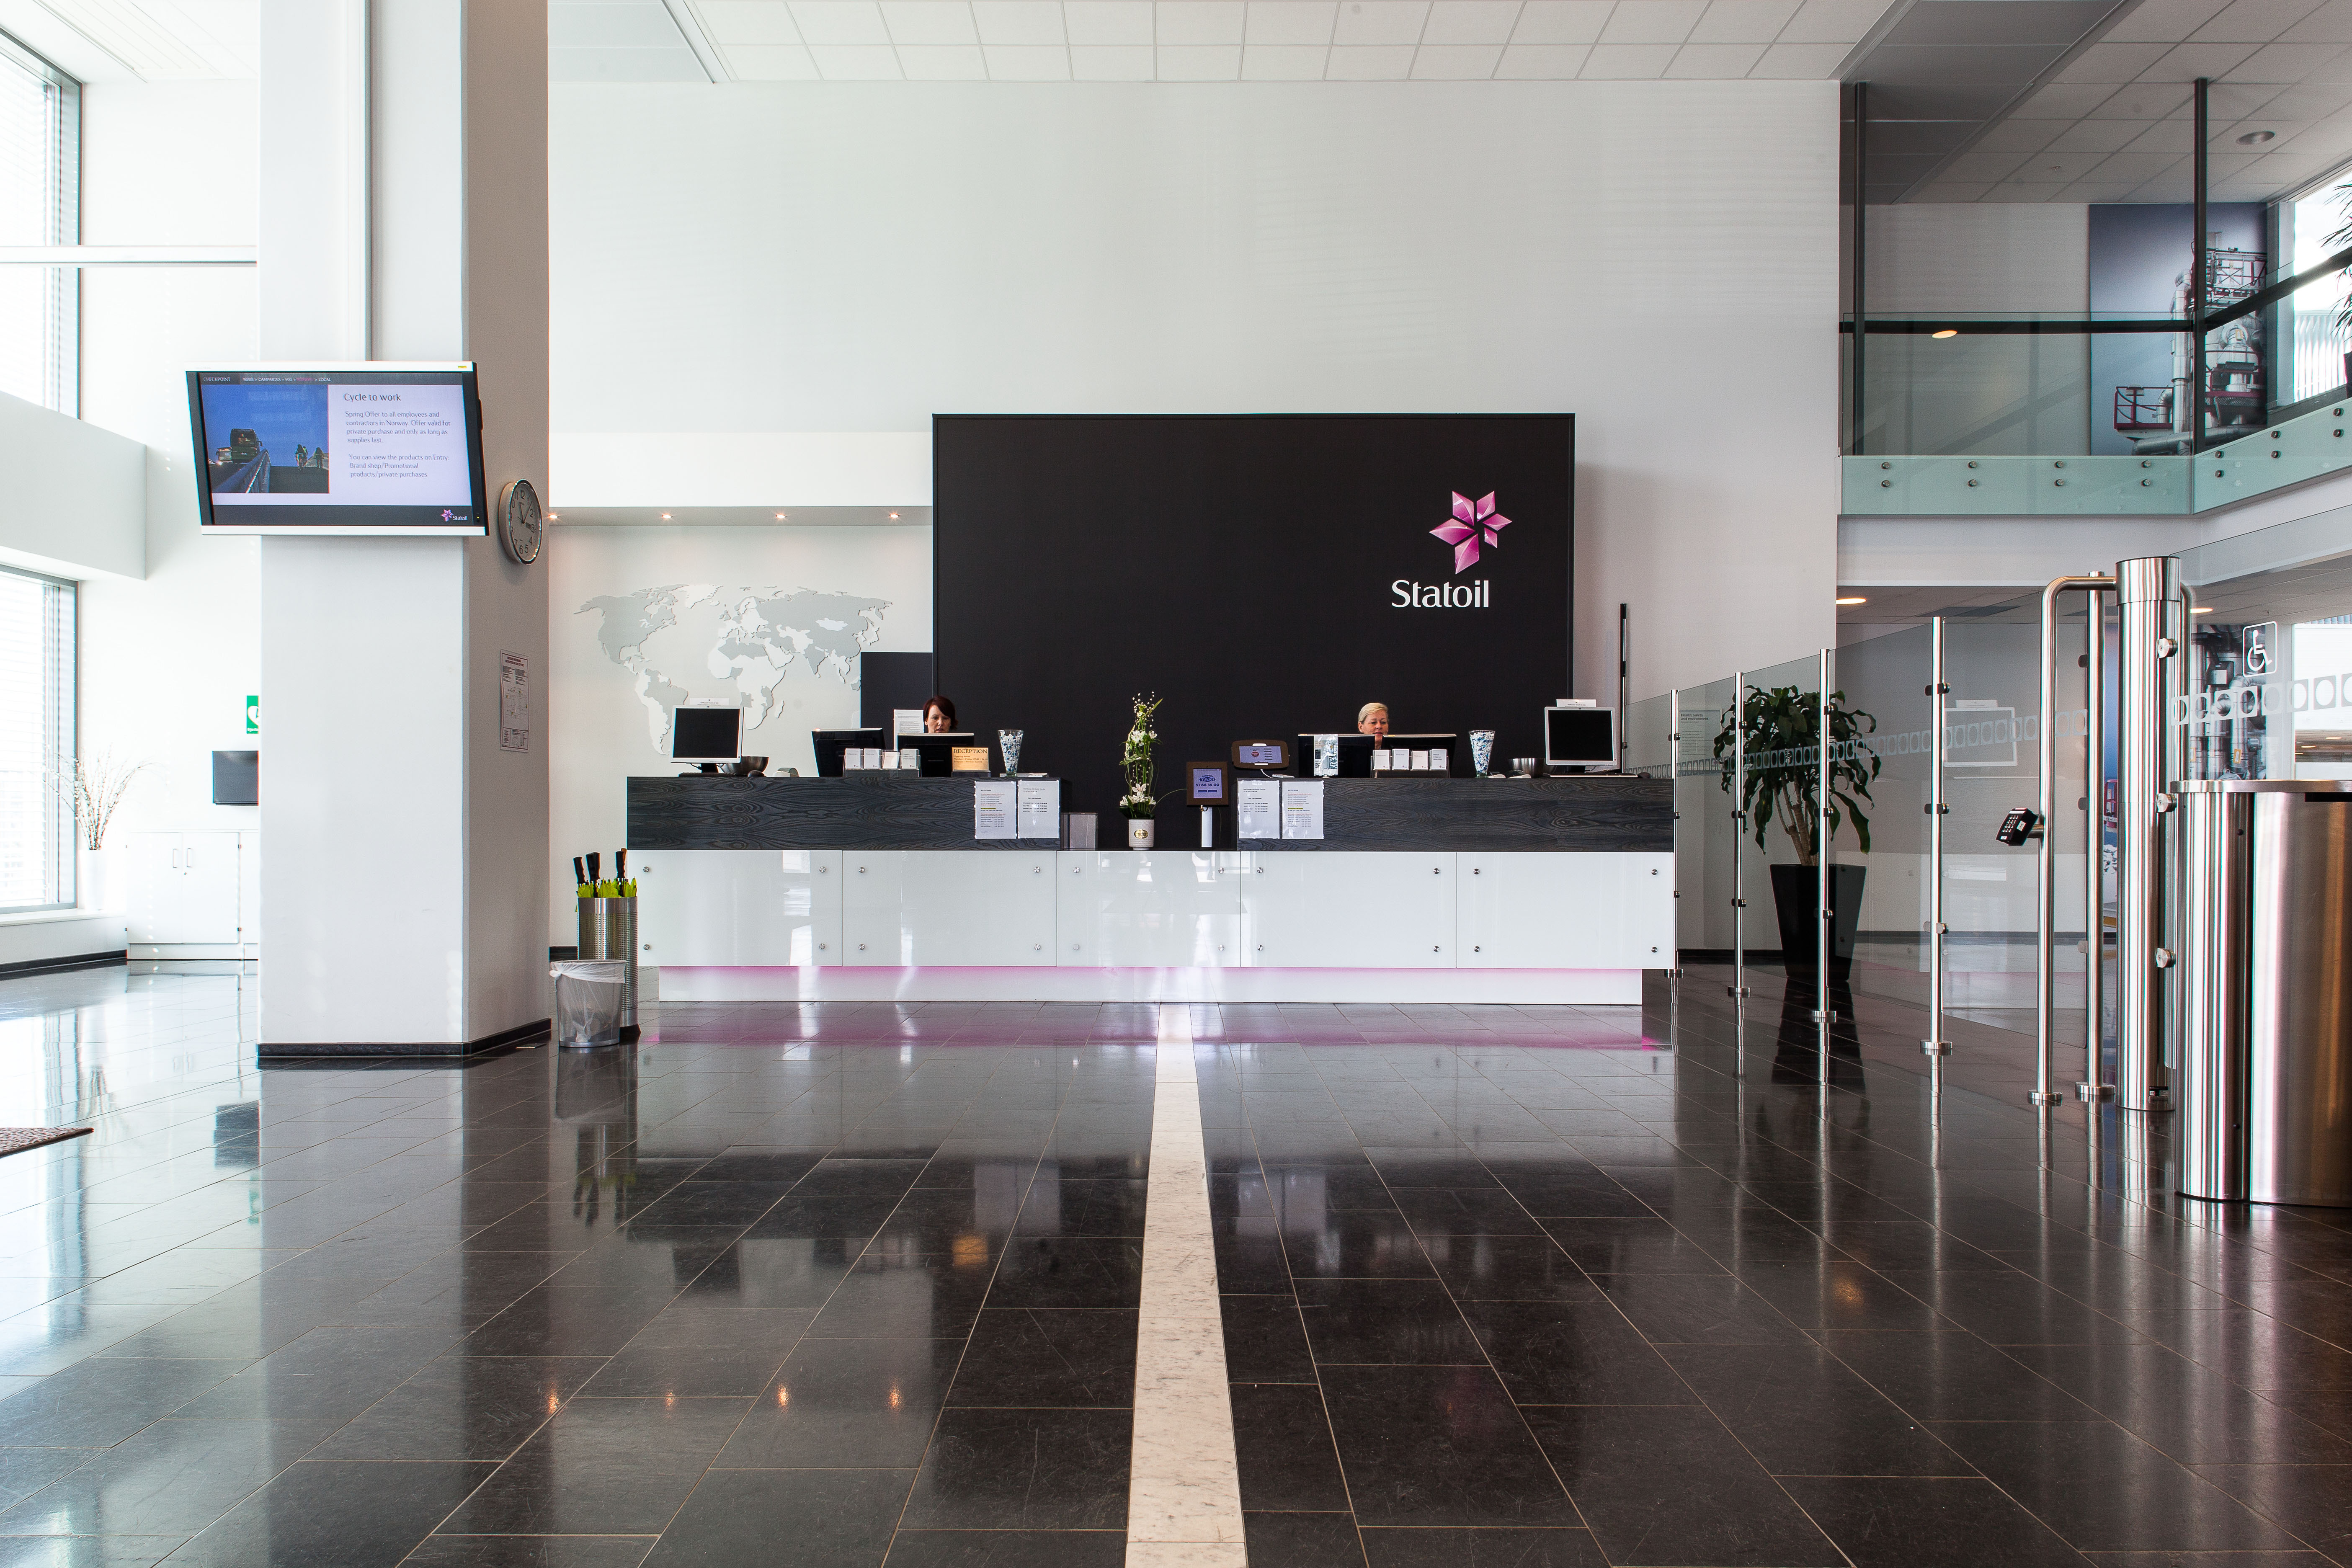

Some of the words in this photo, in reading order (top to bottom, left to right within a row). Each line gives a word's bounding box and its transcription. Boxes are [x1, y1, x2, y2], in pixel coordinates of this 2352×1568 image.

[344, 393, 367, 402] Cycle
[529, 508, 533, 518] 2
[519, 545, 523, 554] 6
[525, 544, 529, 553] 5
[1391, 580, 1489, 608] Statoil
